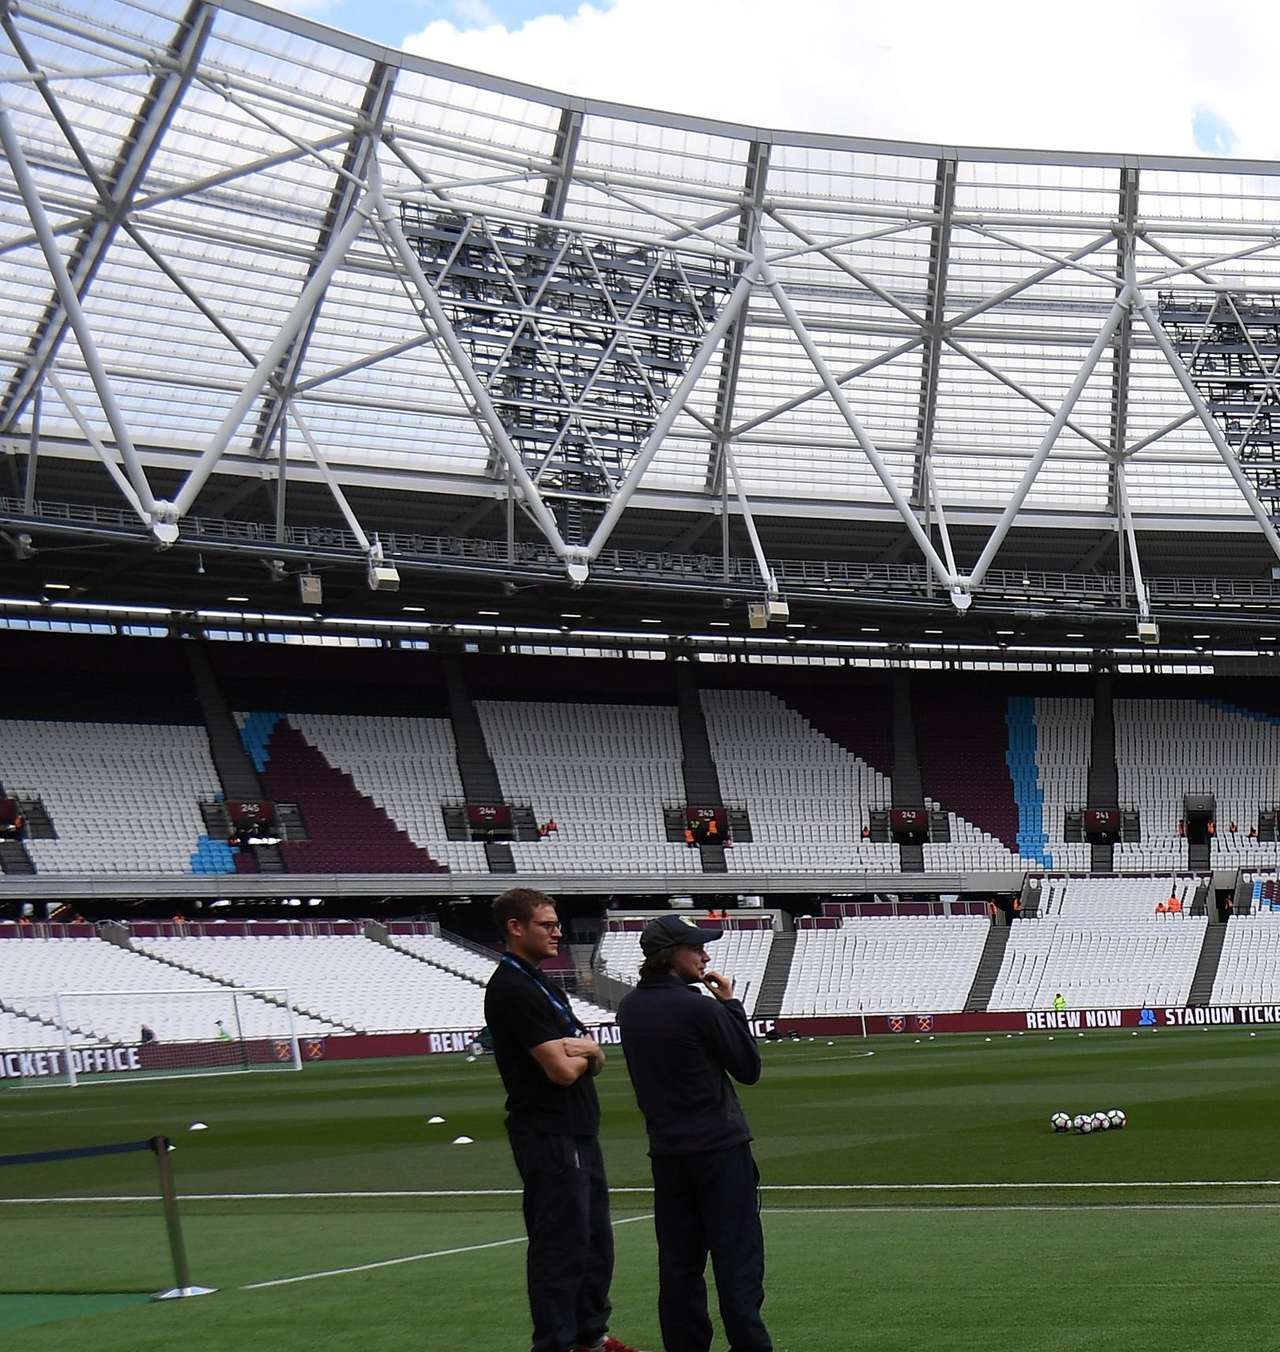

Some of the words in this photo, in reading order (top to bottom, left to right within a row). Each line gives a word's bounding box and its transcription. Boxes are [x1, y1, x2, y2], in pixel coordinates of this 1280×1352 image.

[241, 804, 260, 812] 245
[1027, 1010, 1080, 1029] RENEW
[1086, 1009, 1121, 1027] NOW
[1165, 1007, 1234, 1026] STADIUM
[430, 1032, 479, 1052] RENE
